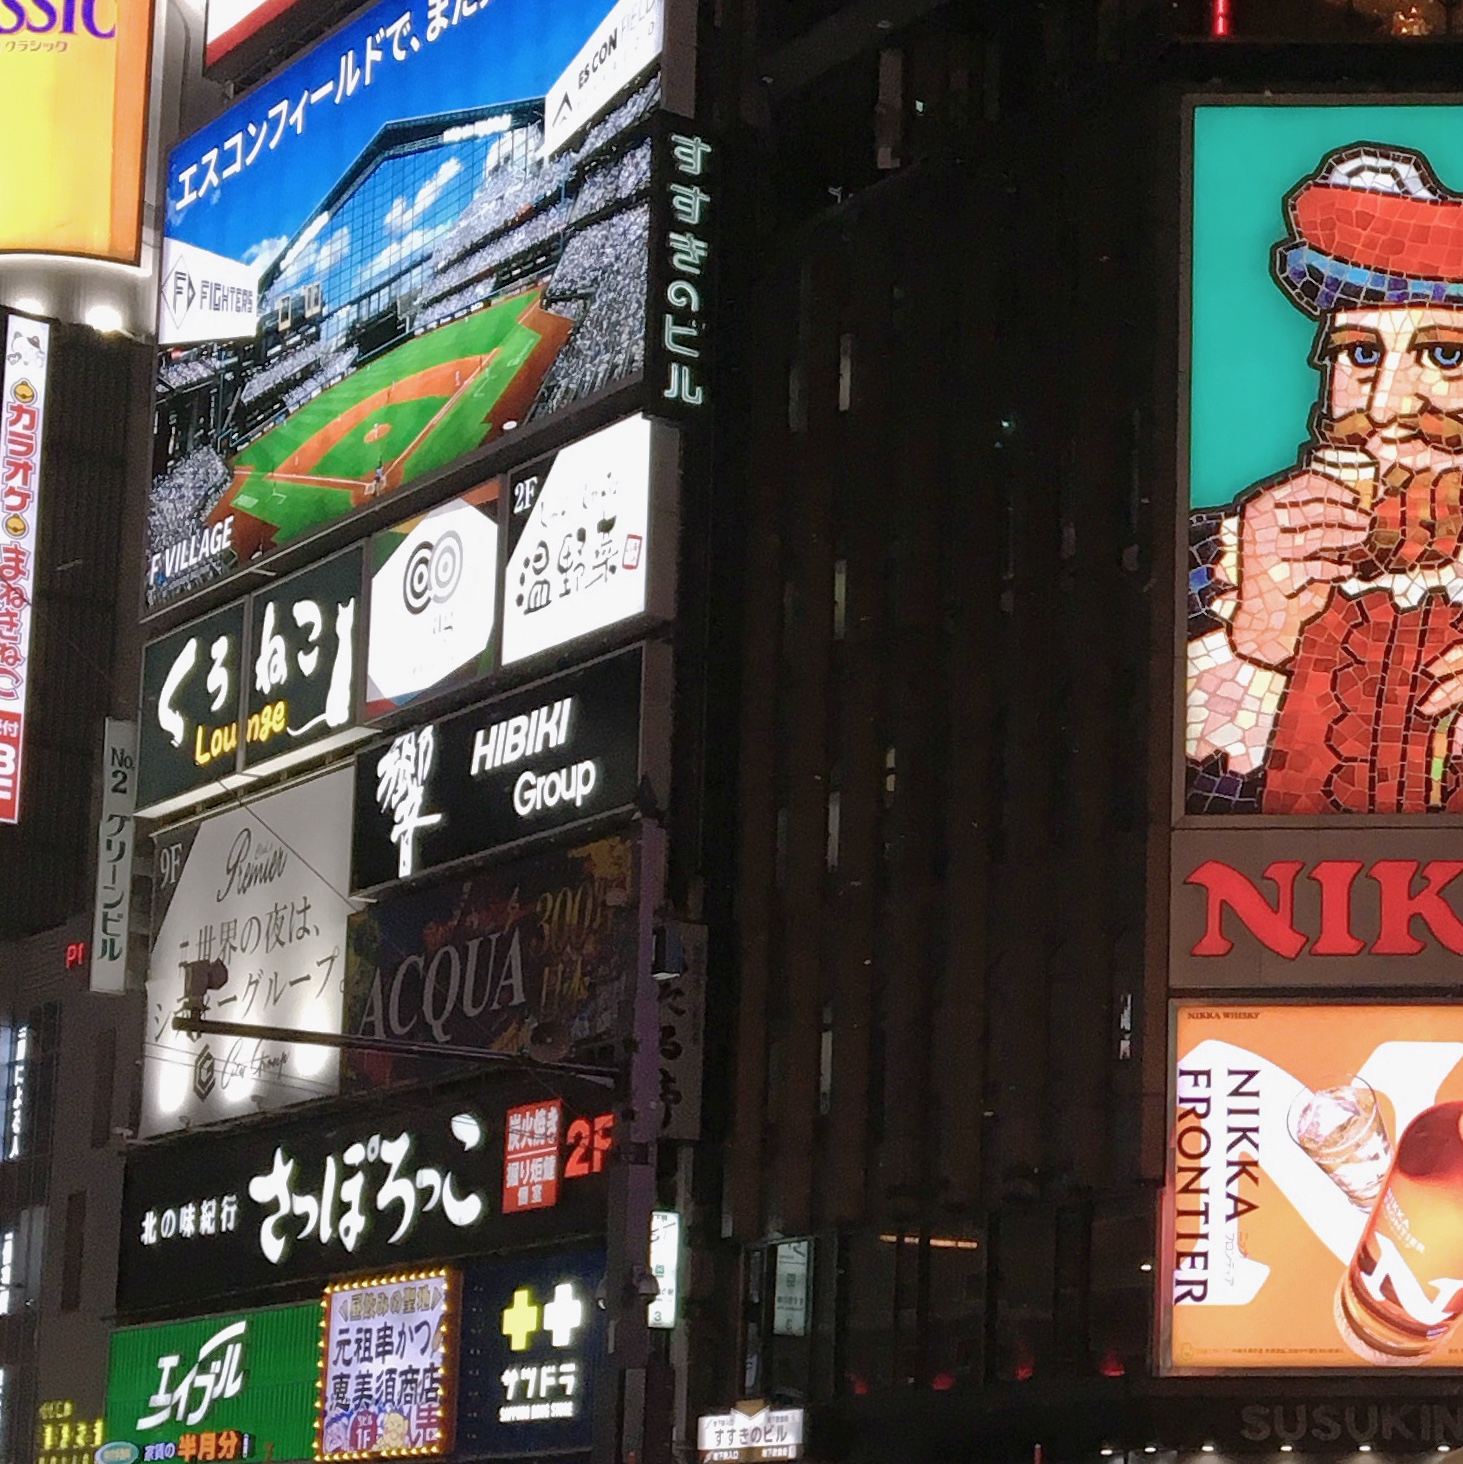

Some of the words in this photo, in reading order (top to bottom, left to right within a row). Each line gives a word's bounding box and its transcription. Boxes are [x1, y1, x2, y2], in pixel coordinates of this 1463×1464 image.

[4, 39, 69, 53] クラシック
[578, 27, 618, 90] ESCON
[200, 279, 253, 314] FIGHTERS
[663, 132, 711, 405] すすきのビル
[8, 402, 38, 512] カラオケ
[513, 476, 538, 514] 2F
[163, 514, 234, 580] VILLAGE
[470, 697, 573, 776] HIBIKI
[513, 759, 597, 817] Group
[159, 843, 183, 890] 9F
[178, 896, 320, 975] 世界の夜は、
[357, 927, 527, 1043] ACQUA
[1187, 1012, 1221, 1020] NIKKA
[1223, 1012, 1260, 1020] WHISKY
[563, 1113, 616, 1178] 2F
[1225, 1068, 1261, 1223] NIKKA
[1174, 1068, 1212, 1305] FRONTIER
[140, 1194, 238, 1246] 北の味紀行
[332, 1320, 432, 1367] 元祖串かつ
[136, 1320, 248, 1431] エイブル
[329, 1362, 441, 1413] 恵美須商店
[500, 1362, 577, 1401] サツドラ
[355, 1429, 372, 1450] 1F
[714, 1424, 788, 1447] すすきのビル
